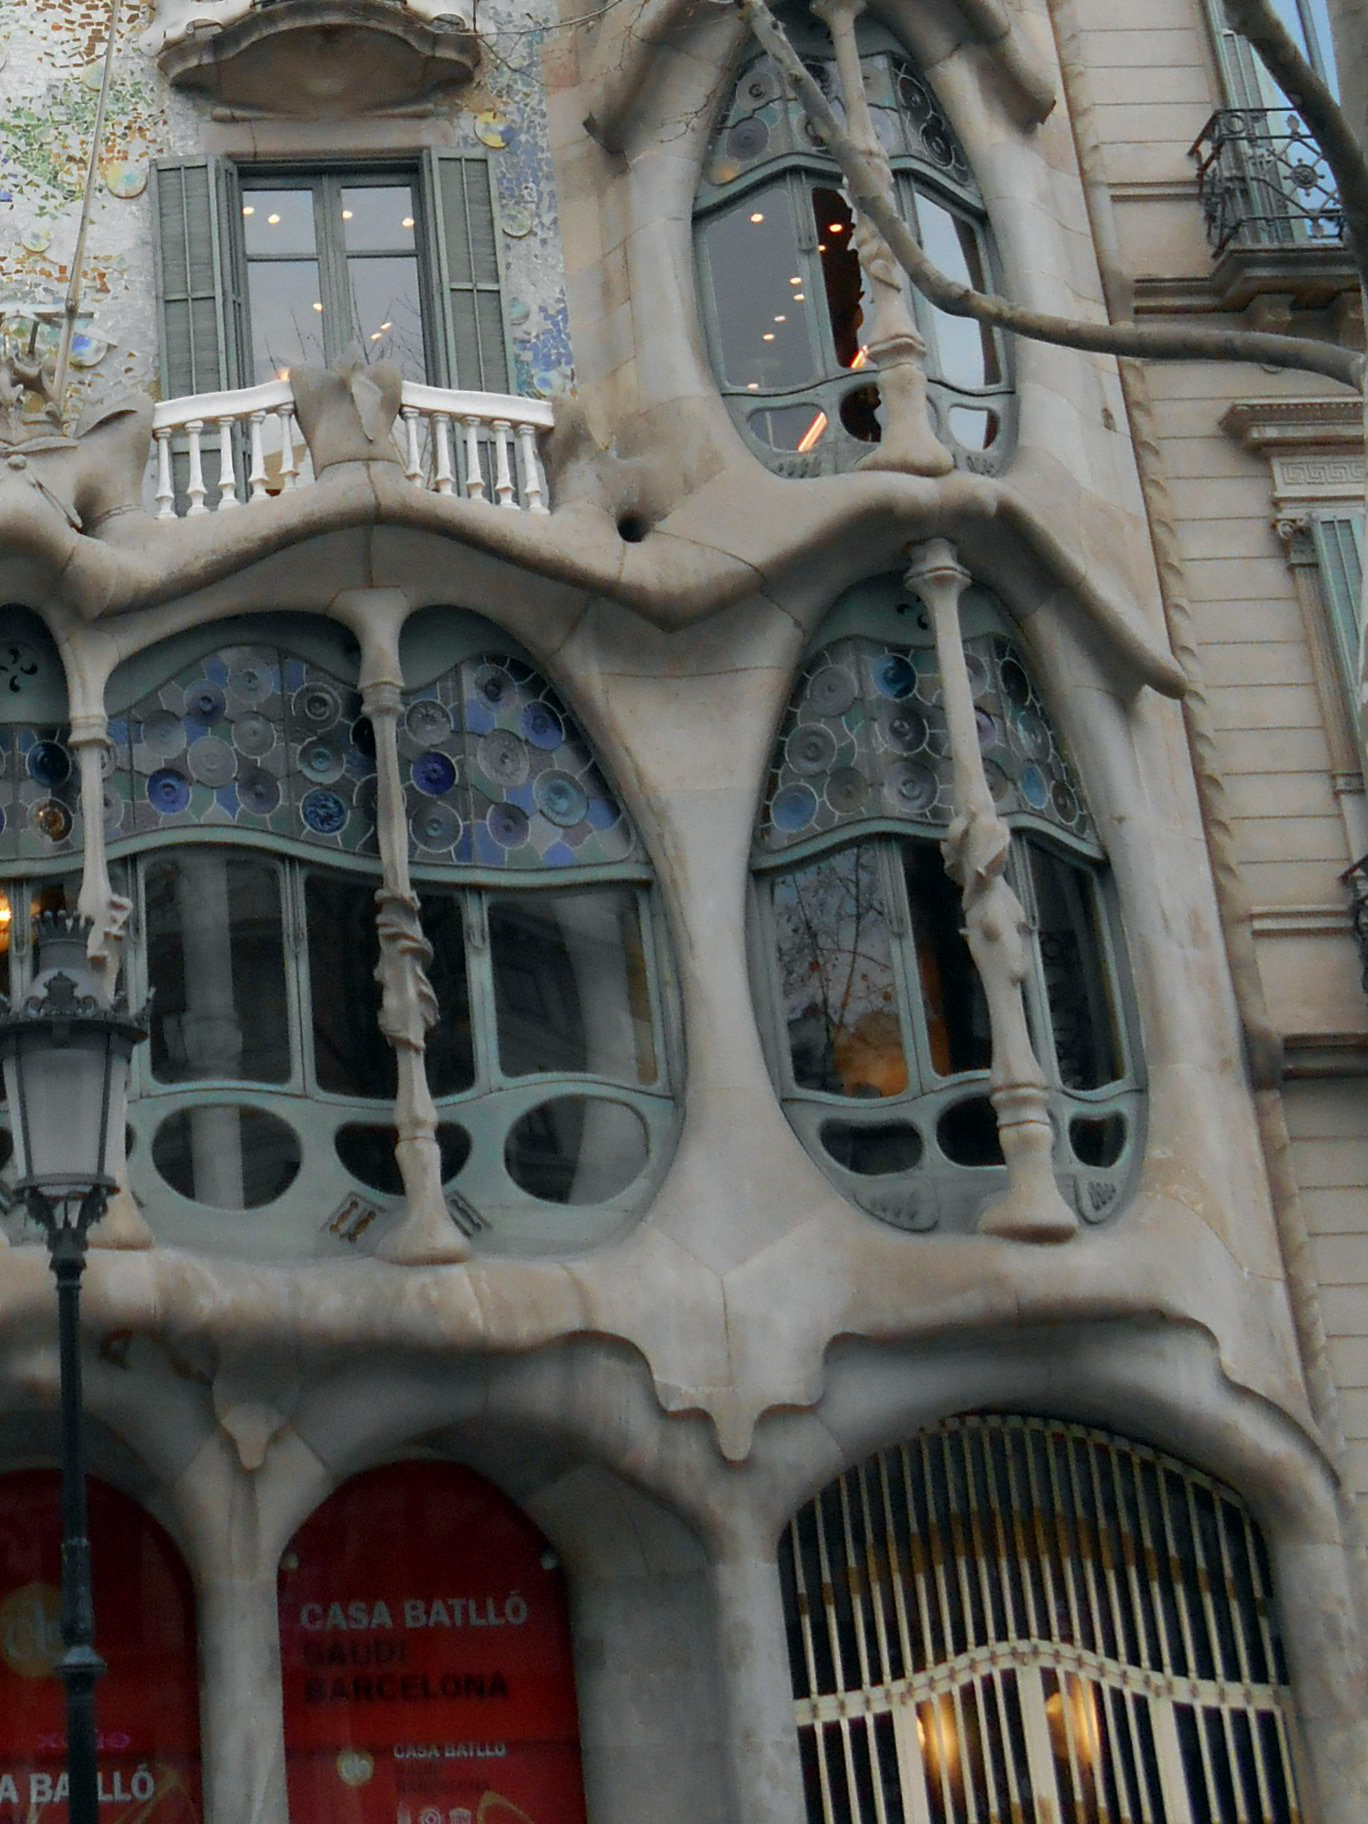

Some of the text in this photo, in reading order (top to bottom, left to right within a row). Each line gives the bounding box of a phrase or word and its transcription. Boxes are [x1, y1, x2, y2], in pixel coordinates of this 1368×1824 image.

[301, 1590, 528, 1631] CASA BATLLÓ
[305, 1672, 508, 1703] BARCELONA
[394, 1745, 440, 1758] CASA
[30, 1763, 155, 1804] BALLÓ
